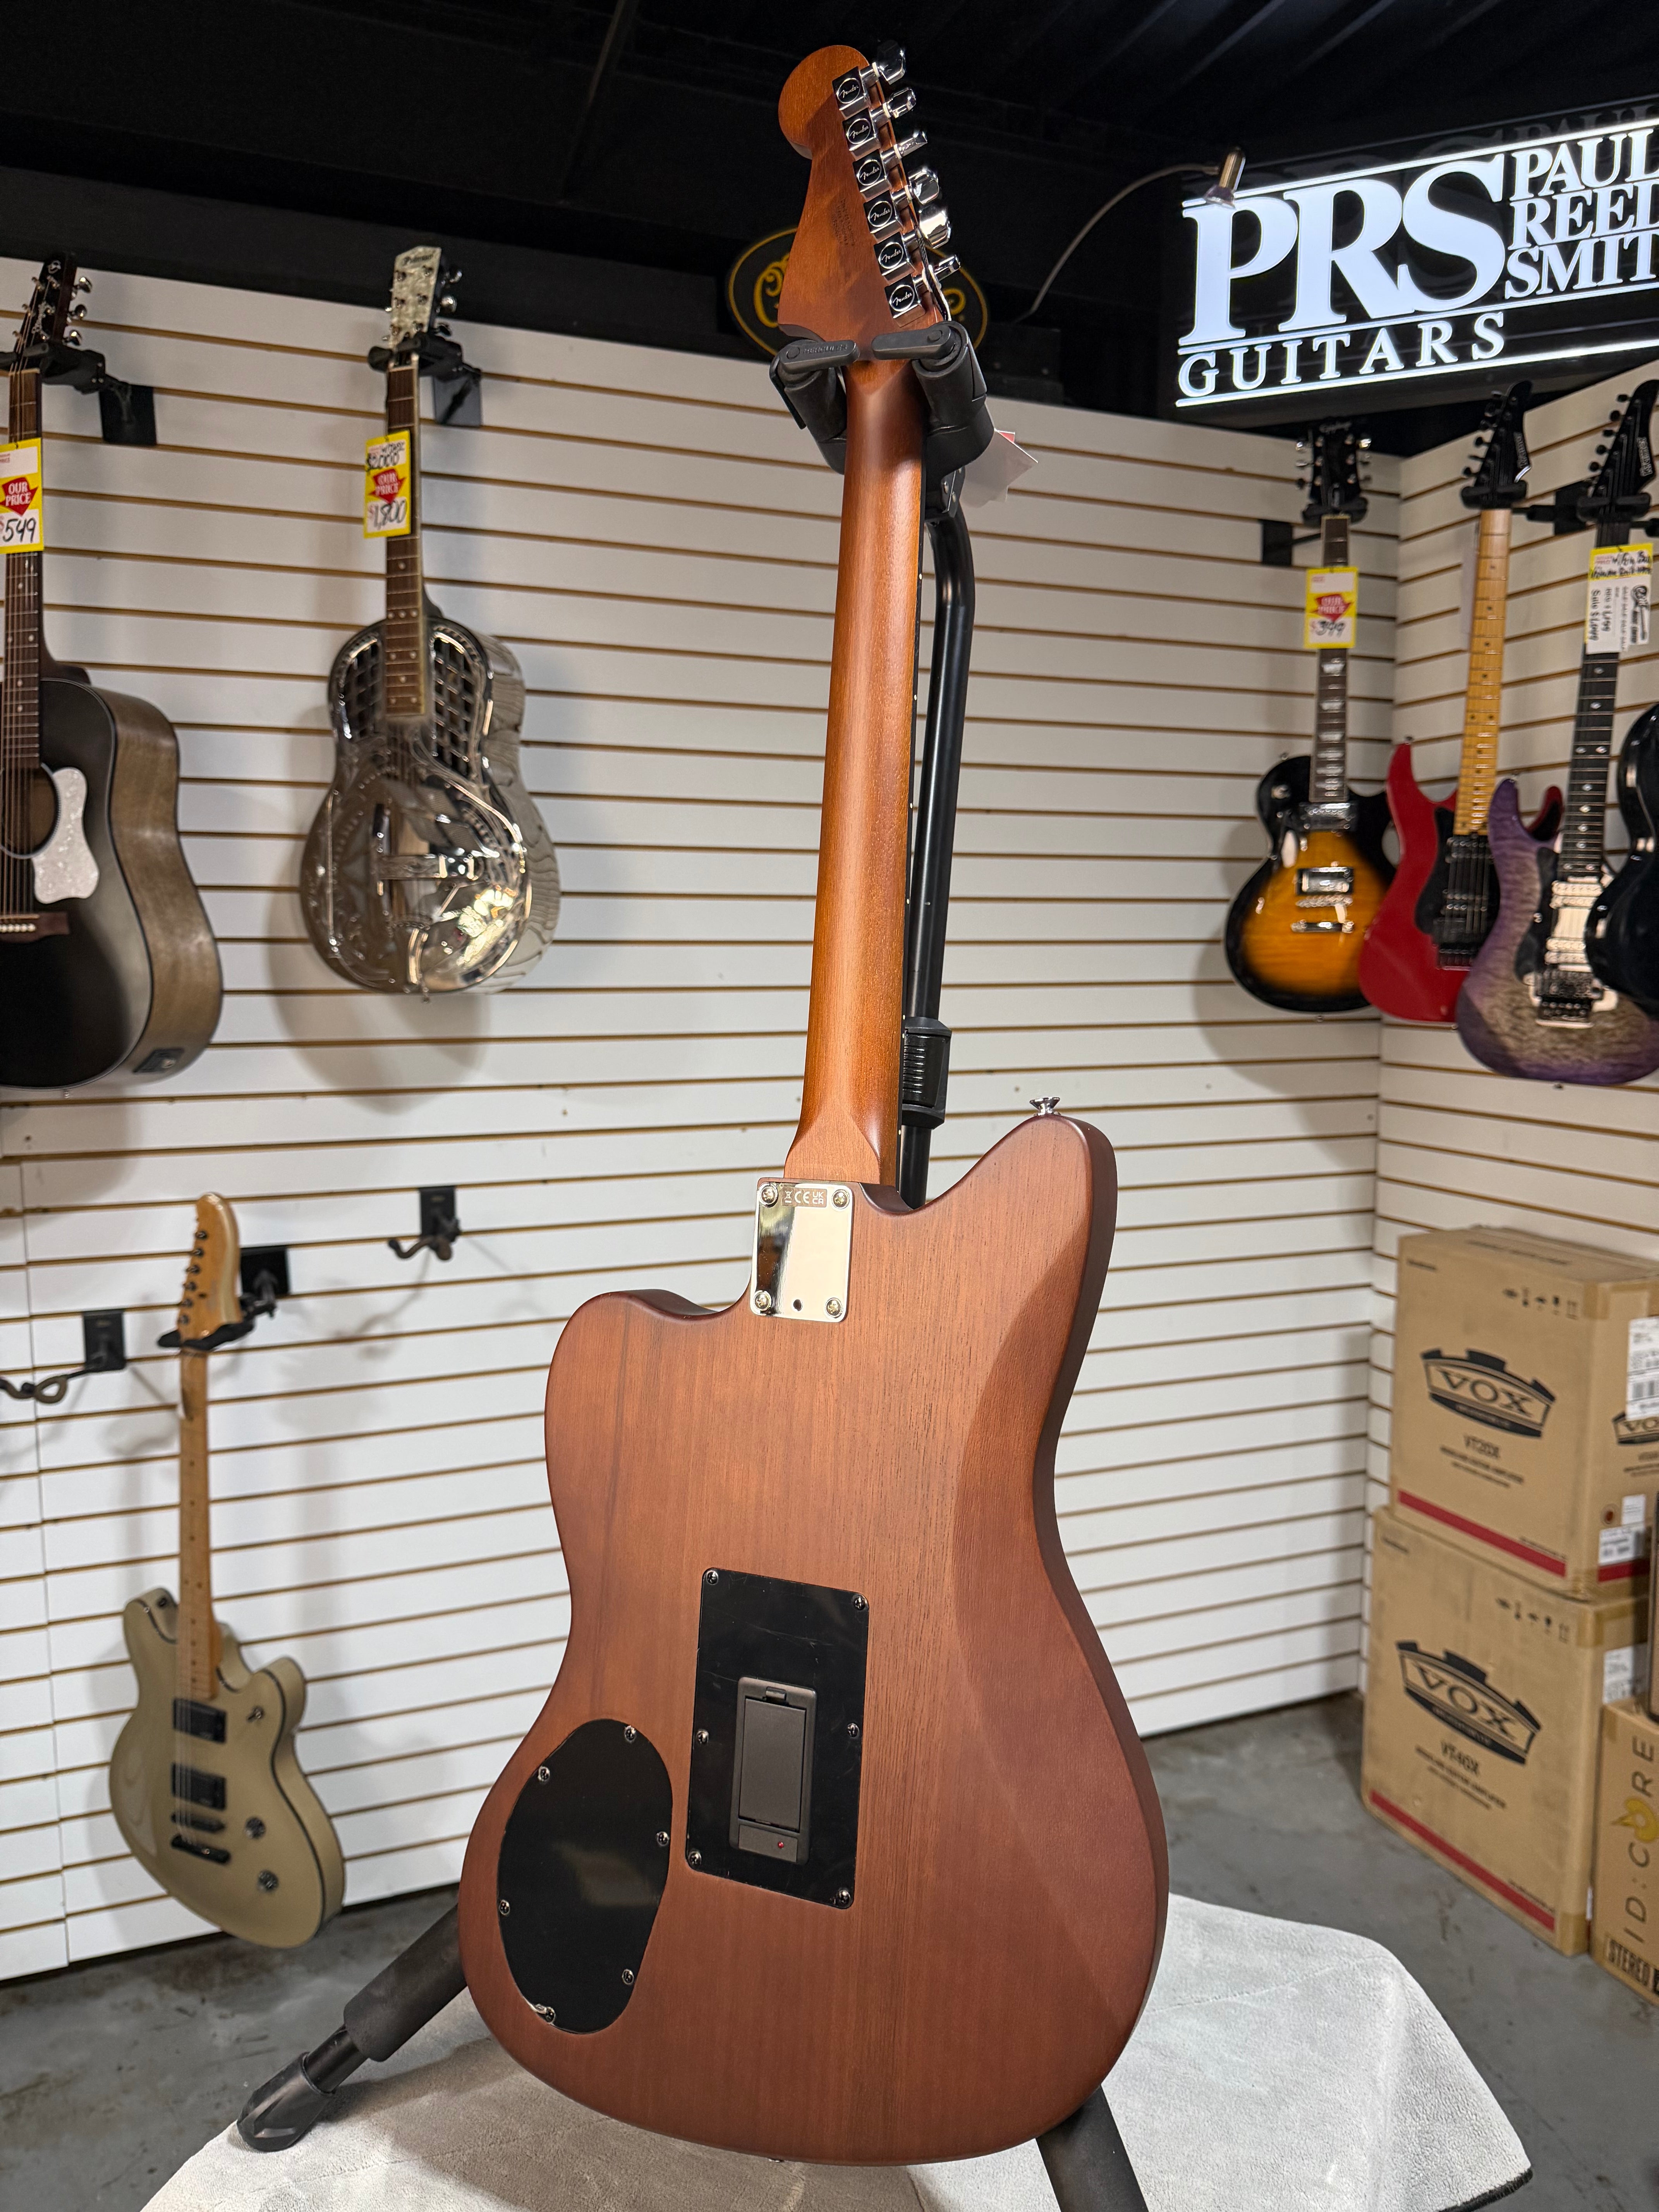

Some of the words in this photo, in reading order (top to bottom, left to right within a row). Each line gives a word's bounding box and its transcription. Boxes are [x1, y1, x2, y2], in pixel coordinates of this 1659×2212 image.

[840, 85, 859, 98] Fender
[850, 125, 869, 139] Fender
[1509, 129, 1659, 201] PAUL
[860, 166, 879, 180] Fender
[871, 208, 890, 221] Fender
[882, 249, 901, 263] Fender
[1178, 154, 1506, 345] PRS
[892, 292, 912, 306] Fender
[1178, 311, 1504, 398] GUITARS
[377, 472, 398, 486] OUR
[8, 481, 28, 495] OUR
[375, 483, 399, 496] PRICE
[5, 492, 31, 507] PRICE
[1436, 1367, 1534, 1417] VOX
[1413, 1661, 1516, 1741] VOX
